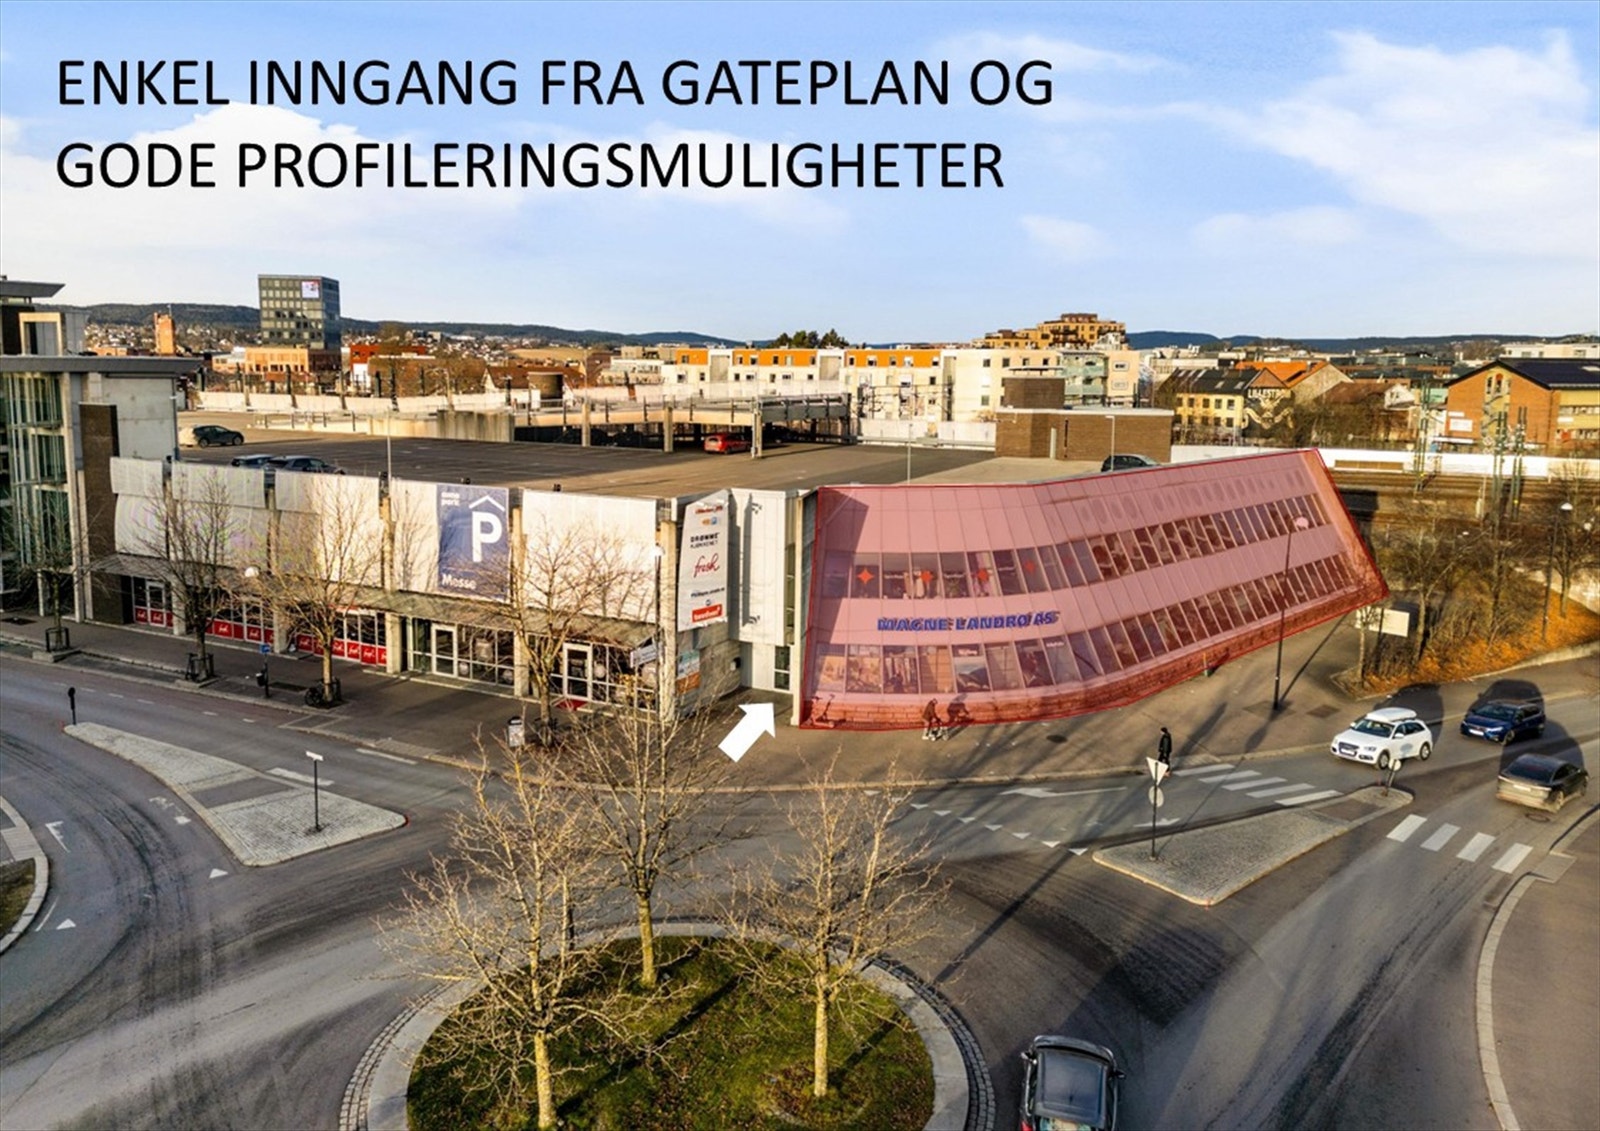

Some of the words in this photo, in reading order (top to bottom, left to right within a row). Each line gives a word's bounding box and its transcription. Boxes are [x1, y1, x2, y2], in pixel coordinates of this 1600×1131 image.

[472, 511, 503, 563] P
[693, 552, 721, 578] fresh
[877, 617, 950, 631] MAGNE
[955, 614, 1030, 631] LANDRØ
[1033, 611, 1057, 626] AS
